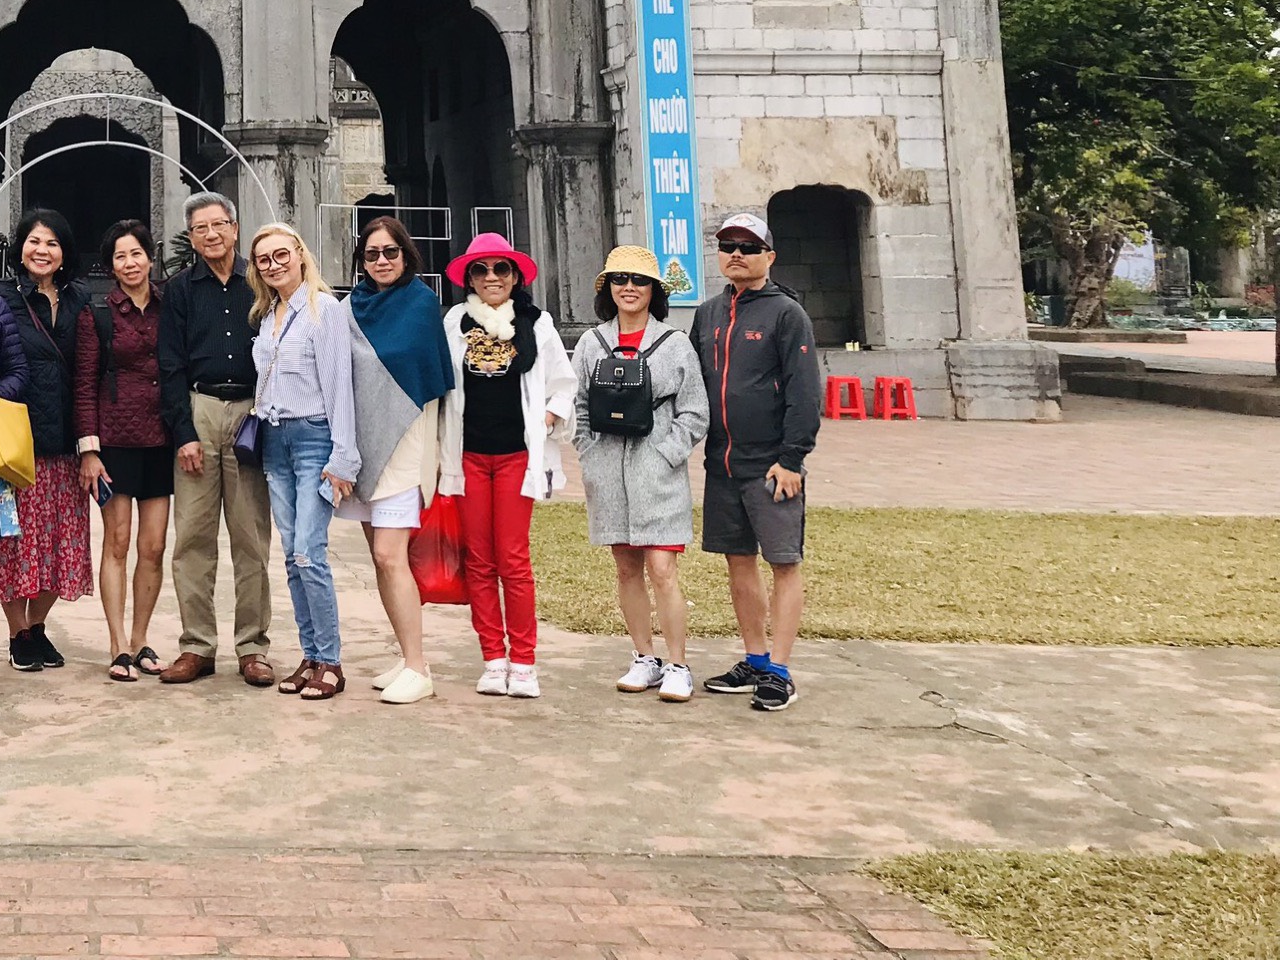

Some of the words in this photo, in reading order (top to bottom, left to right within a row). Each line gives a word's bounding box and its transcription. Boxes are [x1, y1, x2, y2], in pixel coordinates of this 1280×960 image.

[653, 38, 678, 74] CHO
[649, 88, 688, 134] NGƯỜI
[653, 150, 690, 202] THIỆN
[661, 214, 689, 256] TÂM
